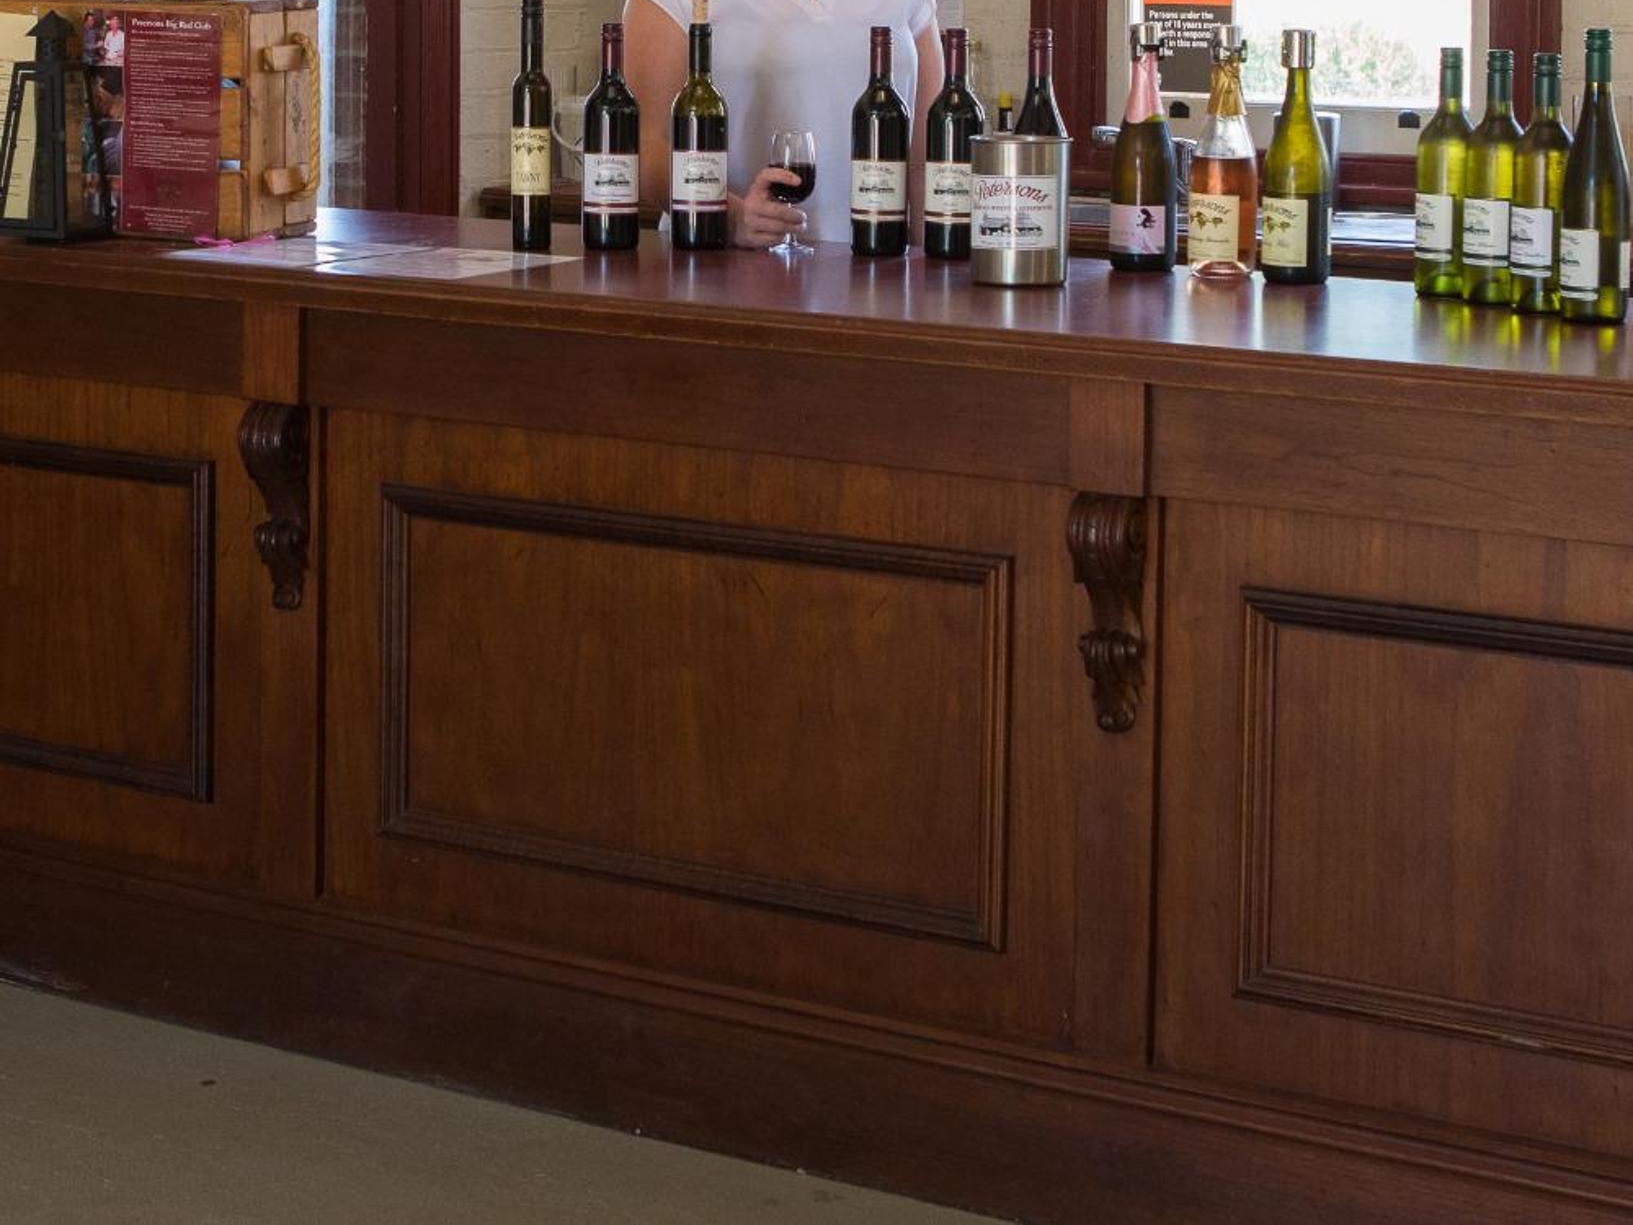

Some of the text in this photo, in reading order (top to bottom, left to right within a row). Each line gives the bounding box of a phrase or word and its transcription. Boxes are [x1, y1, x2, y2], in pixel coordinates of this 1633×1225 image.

[1149, 9, 1214, 19] Persons under the
[1164, 19, 1173, 29] of
[1173, 19, 1182, 29] 18
[1182, 20, 1202, 30] years
[1177, 39, 1191, 48] this
[975, 179, 1049, 204] Petersons
